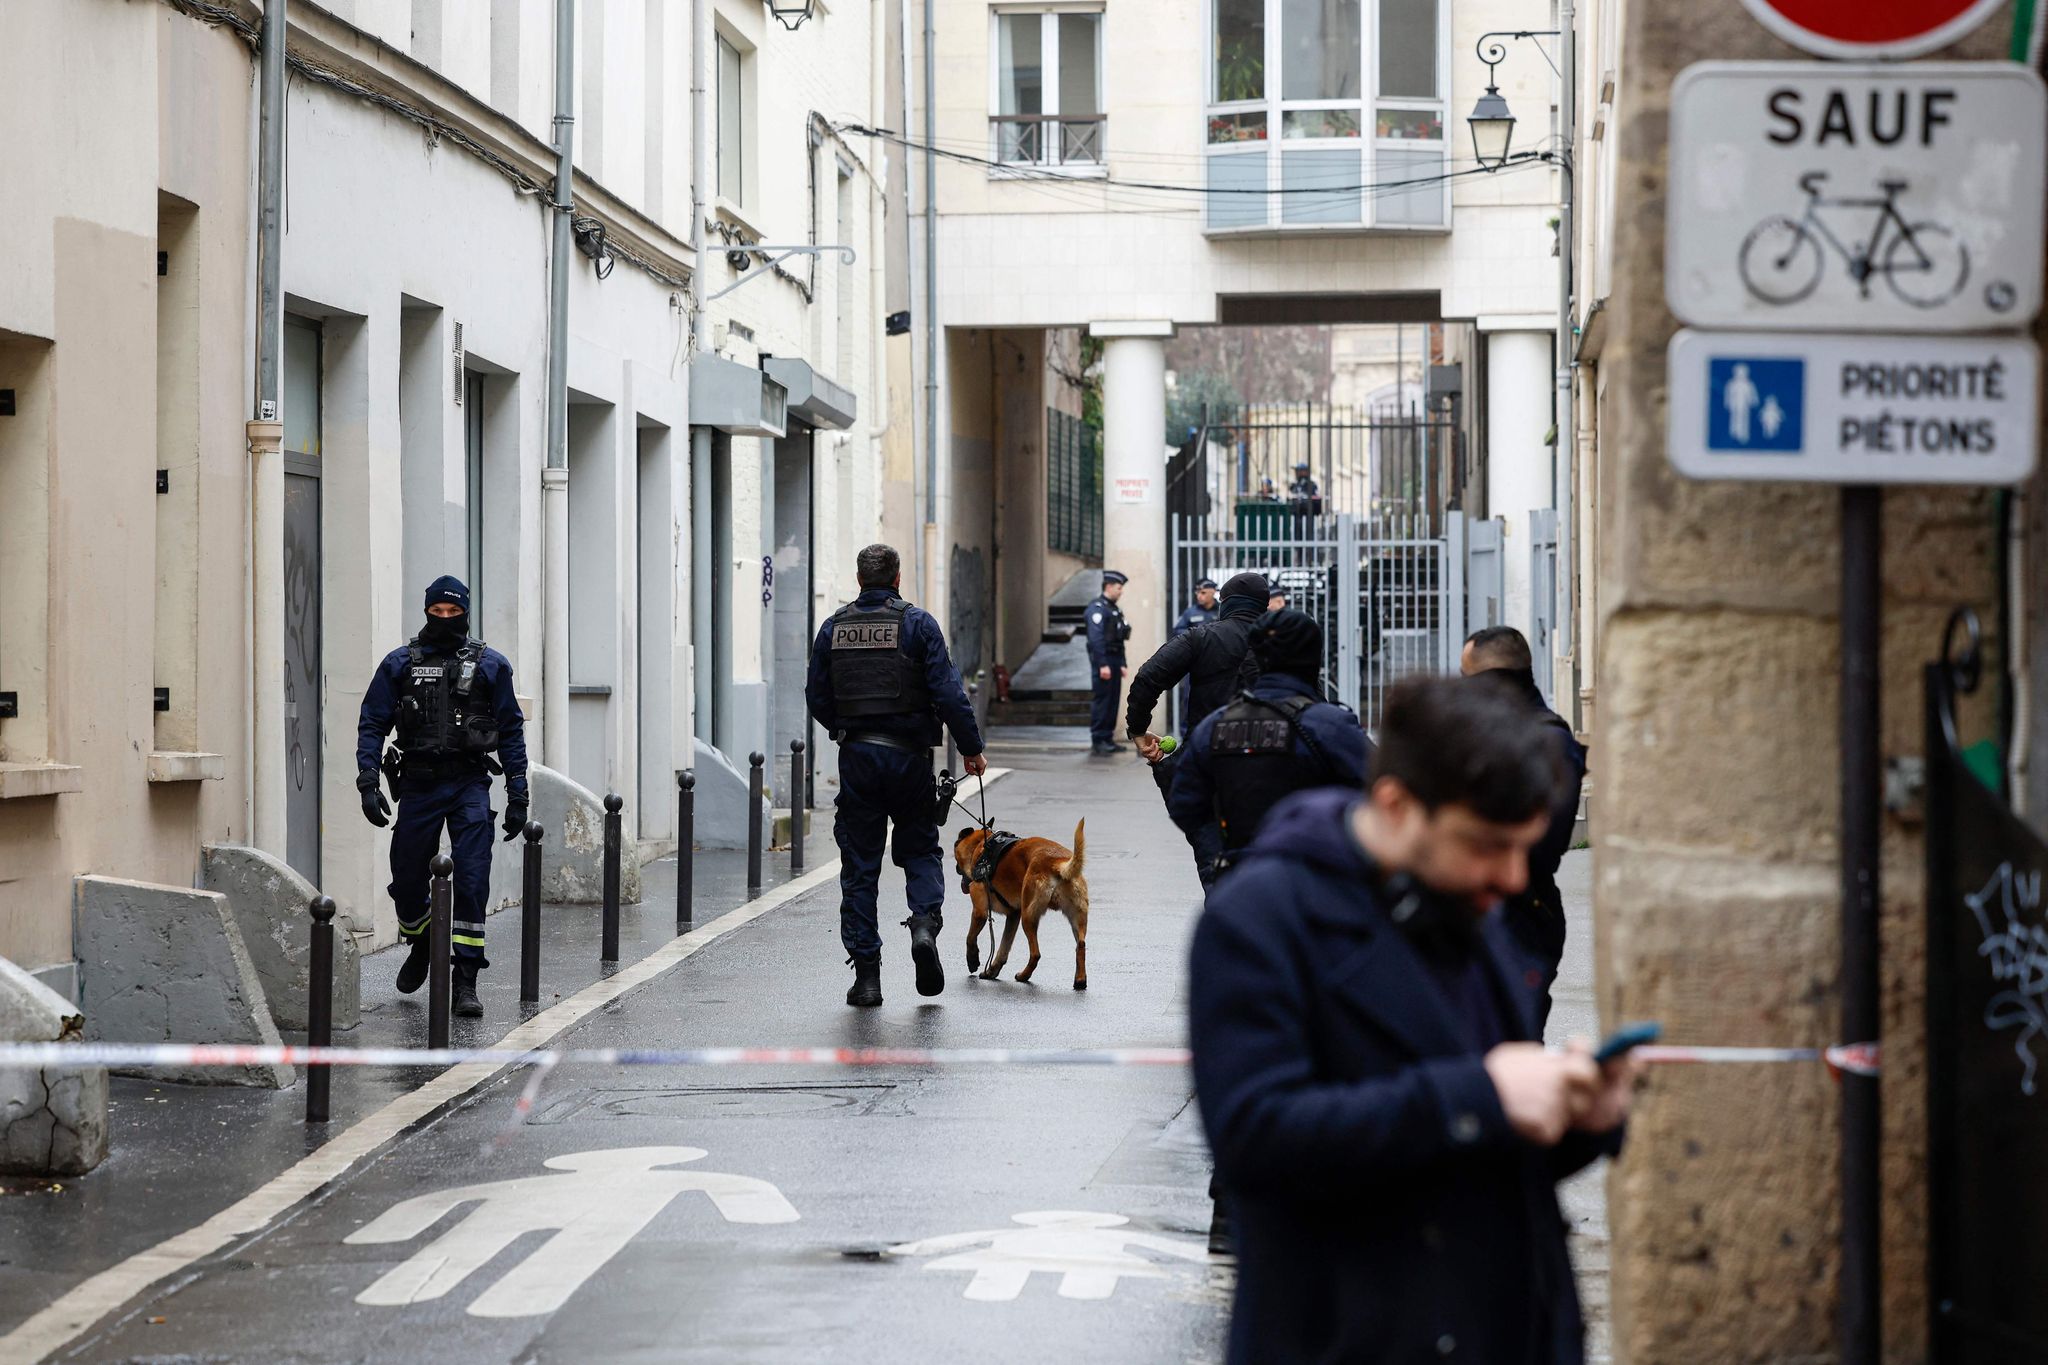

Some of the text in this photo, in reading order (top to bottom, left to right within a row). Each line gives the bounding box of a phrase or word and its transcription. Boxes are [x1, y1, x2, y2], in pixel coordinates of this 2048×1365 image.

[1767, 87, 1957, 146] SAUF
[1840, 356, 2006, 401] PRIORITÉ
[1840, 409, 1996, 453] PIÉTONS
[836, 628, 893, 643] POLICE
[412, 668, 442, 676] POLICE
[1212, 720, 1289, 749] POLICE
